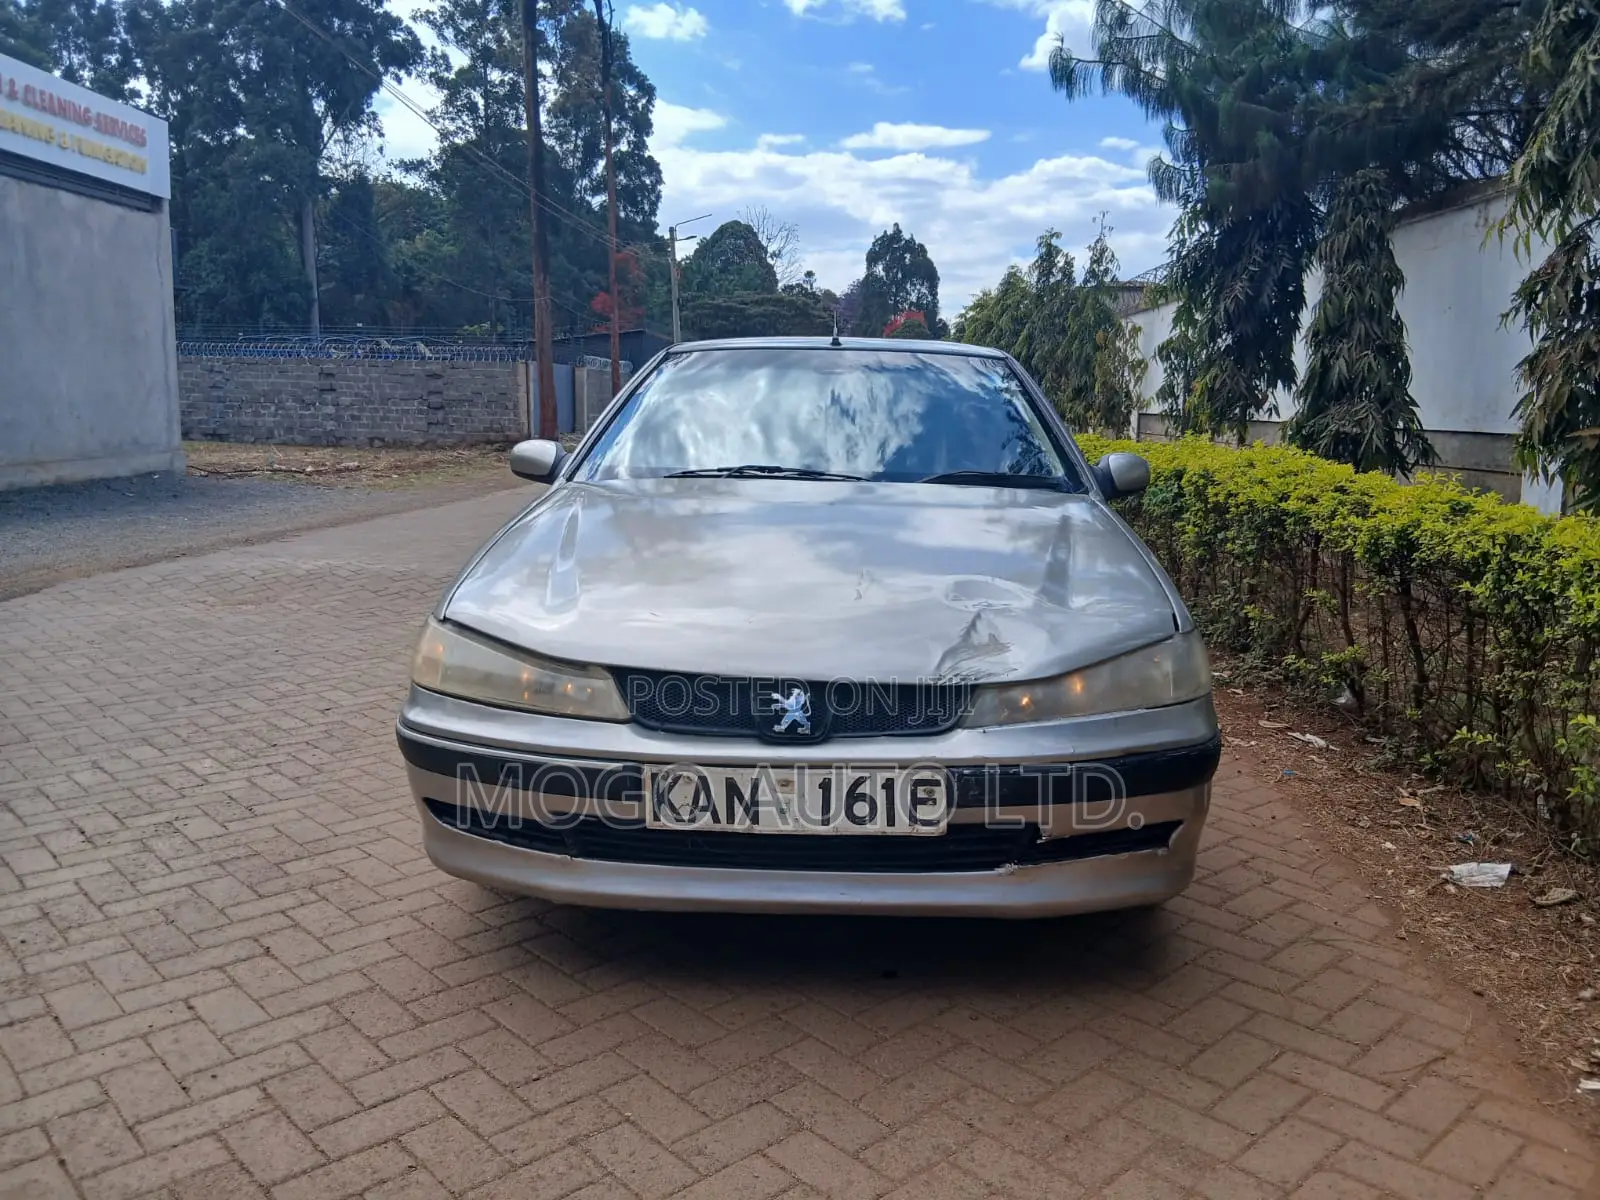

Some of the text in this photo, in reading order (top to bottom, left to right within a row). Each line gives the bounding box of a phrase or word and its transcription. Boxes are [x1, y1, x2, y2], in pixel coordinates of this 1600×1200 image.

[8, 78, 18, 100] &
[23, 84, 92, 126] CLEANING
[94, 111, 147, 147] SERVICES
[650, 772, 761, 826] KAN
